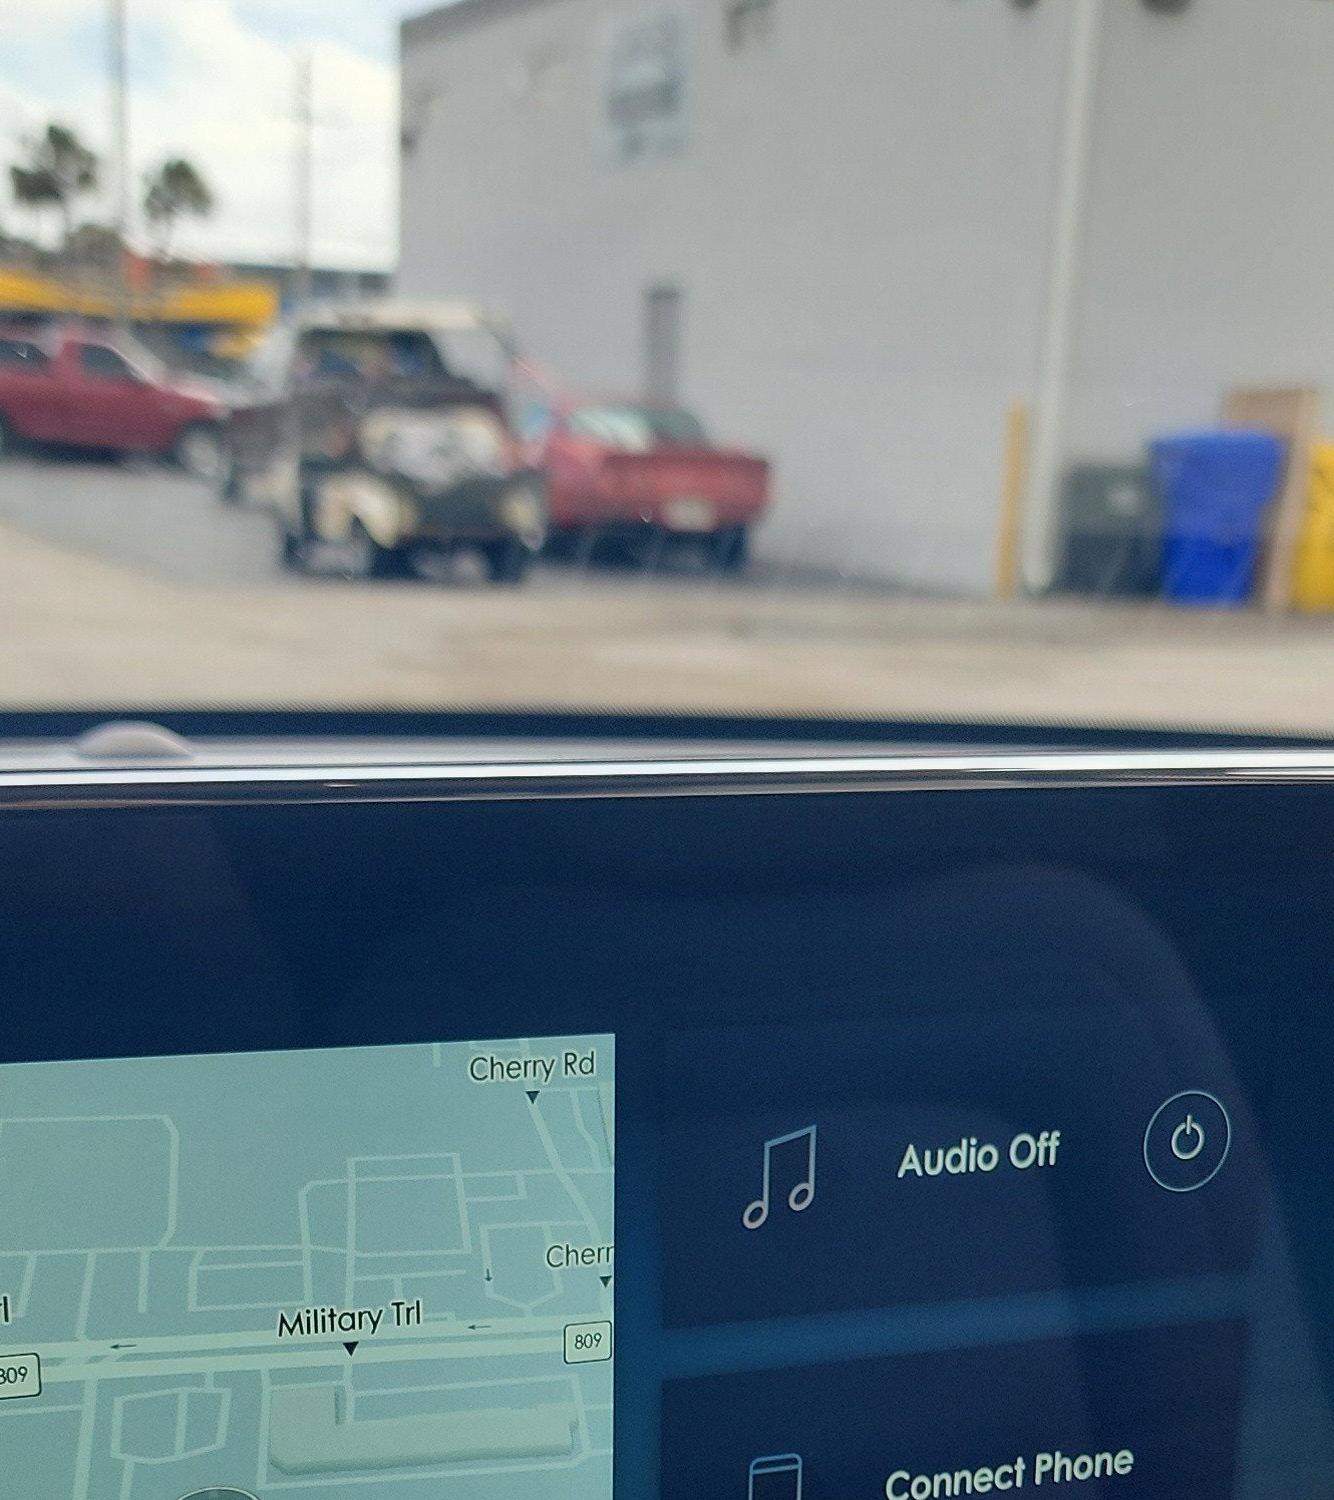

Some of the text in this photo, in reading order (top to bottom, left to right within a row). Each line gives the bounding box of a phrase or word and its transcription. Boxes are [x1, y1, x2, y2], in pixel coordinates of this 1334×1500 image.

[469, 1051, 595, 1084] Cherry Rd
[896, 1131, 1061, 1178] Audio Off
[278, 1300, 421, 1337] Military Trl
[574, 1332, 603, 1349] 809
[1034, 1448, 1134, 1485] Phone
